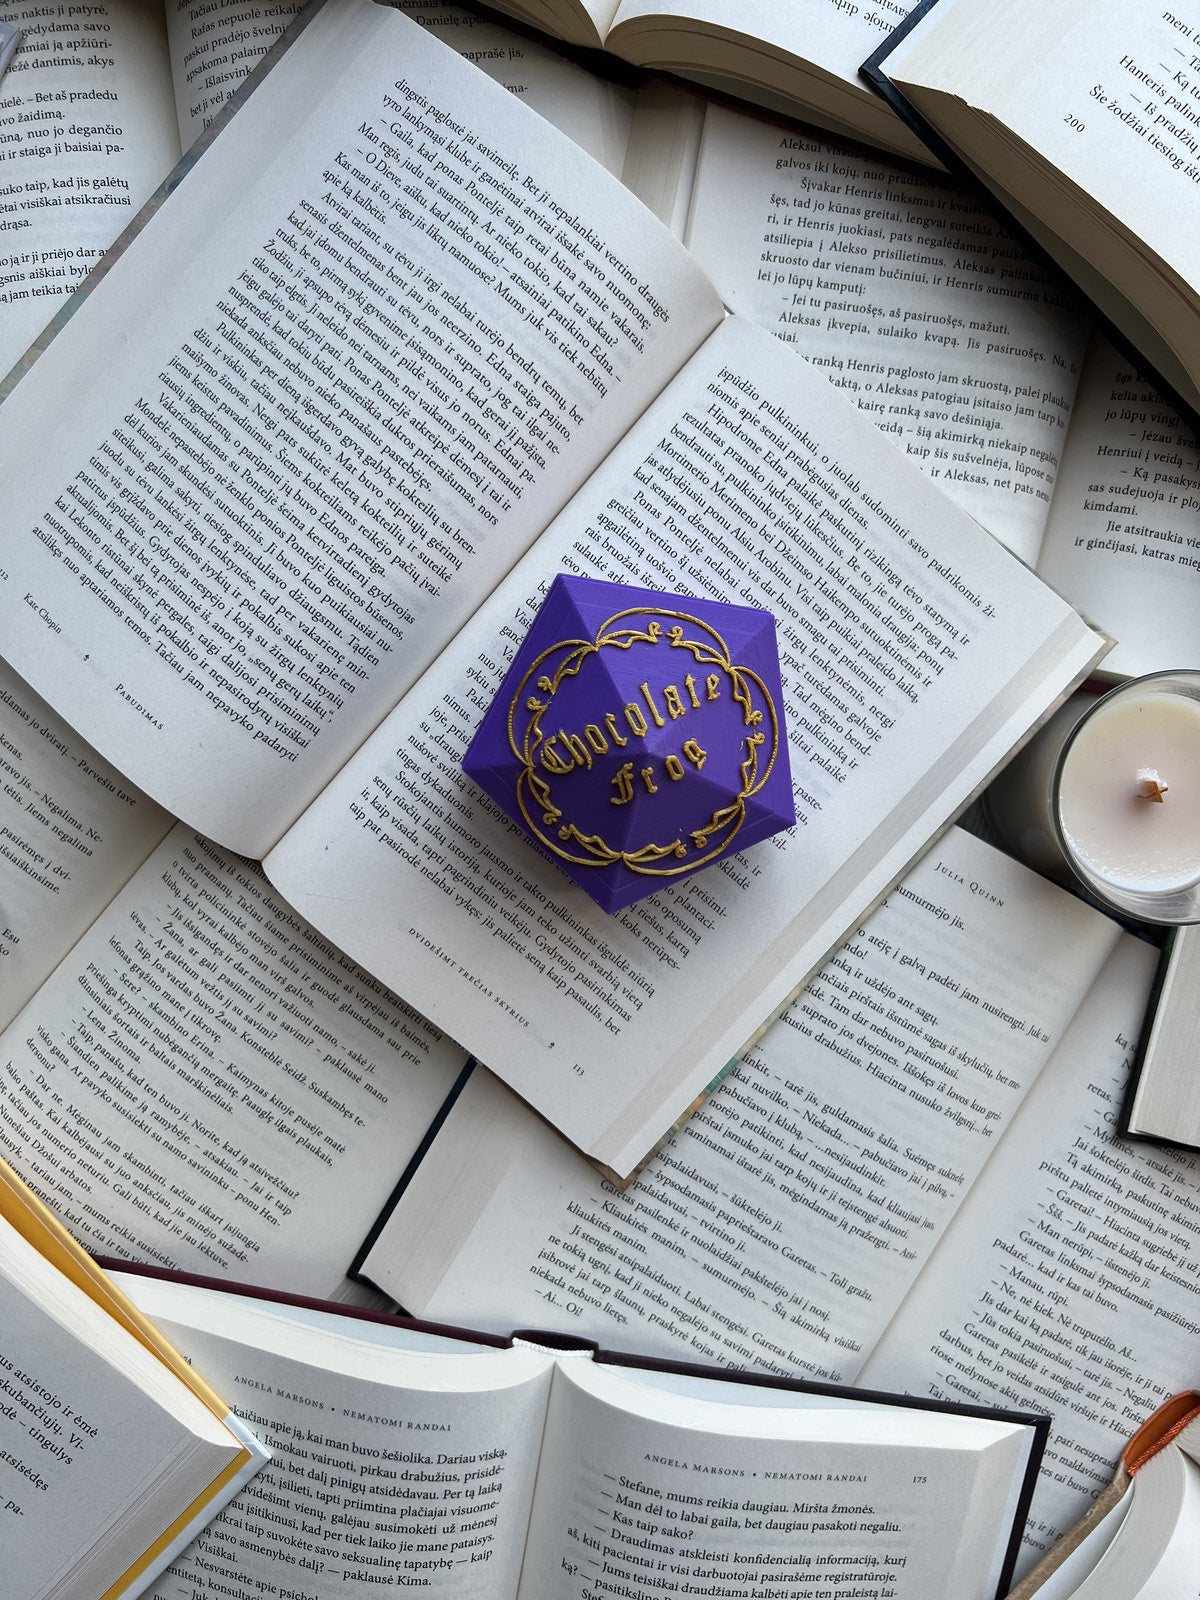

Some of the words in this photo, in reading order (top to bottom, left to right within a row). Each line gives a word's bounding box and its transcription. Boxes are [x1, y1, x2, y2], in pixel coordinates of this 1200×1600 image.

[31, 55, 85, 69] dantimis,
[87, 54, 115, 69] akys
[1119, 55, 1167, 97] Hanteris
[34, 92, 54, 103] Bet
[55, 89, 68, 101] aš
[68, 89, 119, 104] pradedu
[1063, 113, 1086, 133] 200
[1089, 83, 1108, 104] Šie
[1106, 99, 1150, 137] žodžiai
[1147, 133, 1185, 170] tiesiog
[19, 195, 63, 210] visiškai
[64, 193, 132, 206] atsikračiusi
[394, 78, 429, 109] dingstis
[424, 105, 466, 136] paglostė
[461, 130, 480, 146] jai
[476, 143, 520, 181] savimeilę.
[521, 175, 541, 197] Bet
[538, 191, 551, 204] ji
[547, 201, 606, 252] nepalankiai
[604, 249, 638, 286] vertino
[637, 284, 670, 323] draugės
[357, 121, 380, 145] Man
[378, 141, 401, 164] regis,
[399, 156, 425, 180] judu
[424, 176, 440, 190] tai
[436, 186, 479, 226] suartintų.
[480, 221, 496, 236] Ar
[494, 233, 523, 259] nieko
[523, 257, 551, 287] tokio,
[552, 280, 576, 305] kad
[572, 302, 589, 318] tai
[586, 316, 619, 348] sakau?
[757, 268, 772, 282] lei
[772, 272, 785, 286] jo
[787, 273, 813, 290] lūpų
[816, 276, 866, 297] kamputį:
[778, 311, 821, 327] Aleksas
[826, 317, 871, 335] įkvepia,
[877, 325, 918, 340] sulaiko
[924, 330, 960, 349] kvapą.
[966, 337, 981, 350] Jis
[985, 343, 1046, 363] pasiruošęs.
[791, 293, 807, 306] Jei
[809, 297, 821, 308] tu
[823, 300, 886, 319] pasiruošęs,
[888, 307, 901, 319] aš
[902, 311, 966, 329] pasiruošęs,
[968, 321, 1010, 335] mažuti.
[717, 366, 760, 401] įspūdžio
[757, 400, 820, 457] pulkininkui,
[821, 455, 829, 464] o
[828, 461, 861, 493] juolab
[860, 493, 910, 539] sudominti
[907, 538, 929, 559] savo
[927, 558, 982, 608] padrikomis
[982, 604, 996, 618] ži-
[1083, 499, 1138, 516] kimdami.
[1074, 536, 1085, 547] ir
[1085, 538, 1138, 555] ginčijasi,
[1141, 544, 1176, 562] katras
[23, 592, 39, 611] Kate
[38, 607, 62, 635] Chopin
[32, 526, 64, 558] atsilikęs
[62, 556, 80, 575] nuo
[79, 573, 125, 618] aptariamos
[124, 615, 152, 646] temos.
[154, 640, 185, 674] Tačiau
[182, 670, 205, 692] jam
[205, 690, 254, 731] nepavyko
[252, 730, 300, 762] padaryti
[114, 682, 164, 730] PABUDIMAS
[540, 673, 720, 774] Chocolate
[610, 737, 707, 805] Frog
[894, 879, 950, 921] sumurmėjo
[948, 915, 964, 931] jis.
[933, 861, 964, 885] JULIA
[969, 881, 1005, 908] QUINN
[161, 870, 181, 899] klubų,
[182, 893, 199, 911] kol
[197, 908, 220, 929] vyrai
[217, 924, 249, 955] kalbėjo
[248, 953, 269, 972] man
[269, 969, 288, 986] virš
[284, 983, 315, 1009] galvos.
[349, 802, 366, 821] taip
[362, 818, 382, 835] pat
[378, 832, 422, 868] pasirodė
[419, 866, 456, 896] nelabai
[454, 893, 483, 920] vykęs:
[479, 915, 496, 930] jis
[492, 927, 527, 954] palietė
[524, 952, 546, 974] seną
[545, 966, 567, 990] kaip
[564, 987, 603, 1022] pasaulis,
[604, 1016, 621, 1036] bet
[408, 927, 457, 967] DVIDEŠIMT
[458, 966, 494, 998] TREČIAS
[494, 996, 530, 1028] SKYRIUS
[77, 974, 114, 1016] džinsiniais
[112, 1012, 141, 1040] šortais
[139, 1036, 150, 1047] ir
[148, 1042, 177, 1071] baltais
[176, 1068, 234, 1115] marškinėliais.
[992, 1238, 1034, 1268] padarė...
[1036, 1260, 1058, 1279] kad
[1056, 1272, 1066, 1284] ir
[1065, 1276, 1082, 1292] kas
[1081, 1288, 1096, 1299] tai
[1094, 1291, 1119, 1313] buvo.
[13, 1369, 62, 1409] atsistojo
[61, 1405, 74, 1418] ir
[73, 1415, 99, 1438] ėmė
[234, 1375, 273, 1394] ANGELA
[275, 1388, 324, 1410] MARSONS
[342, 1408, 403, 1428] NEMATOMI
[406, 1421, 451, 1432] RANDAI
[28, 1427, 73, 1465] tingulys
[264, 1434, 308, 1459] Išmokau
[311, 1452, 357, 1473] vairuoti,
[359, 1465, 397, 1479] pirkau
[400, 1470, 461, 1483] drabužius,
[463, 1464, 505, 1487] prisidė-
[643, 1453, 688, 1470] ANGELA
[692, 1463, 745, 1477] MARSONS
[764, 1471, 823, 1481] NEMATOMI
[826, 1474, 867, 1483] RANDAI
[618, 1475, 663, 1500] Stefane,
[666, 1492, 704, 1506] mums
[705, 1497, 739, 1510] reikia
[741, 1500, 789, 1515] daugiau.
[792, 1502, 829, 1514] Miršta
[831, 1503, 875, 1515] žmonės.
[912, 1475, 928, 1484] 175
[615, 1493, 642, 1511] Man
[644, 1502, 663, 1517] dėl
[665, 1508, 678, 1520] to
[680, 1510, 709, 1525] labai
[710, 1516, 741, 1529] gaila,
[744, 1517, 763, 1530] bet
[764, 1518, 809, 1534] daugiau
[810, 1520, 857, 1534] pasakoti
[859, 1521, 902, 1535] negaliu.
[610, 1527, 675, 1555] Draudimas
[678, 1548, 730, 1563] atskleisti
[733, 1552, 812, 1568] konfidencialią
[815, 1553, 880, 1568] informaciją,
[883, 1554, 907, 1568] kurį
